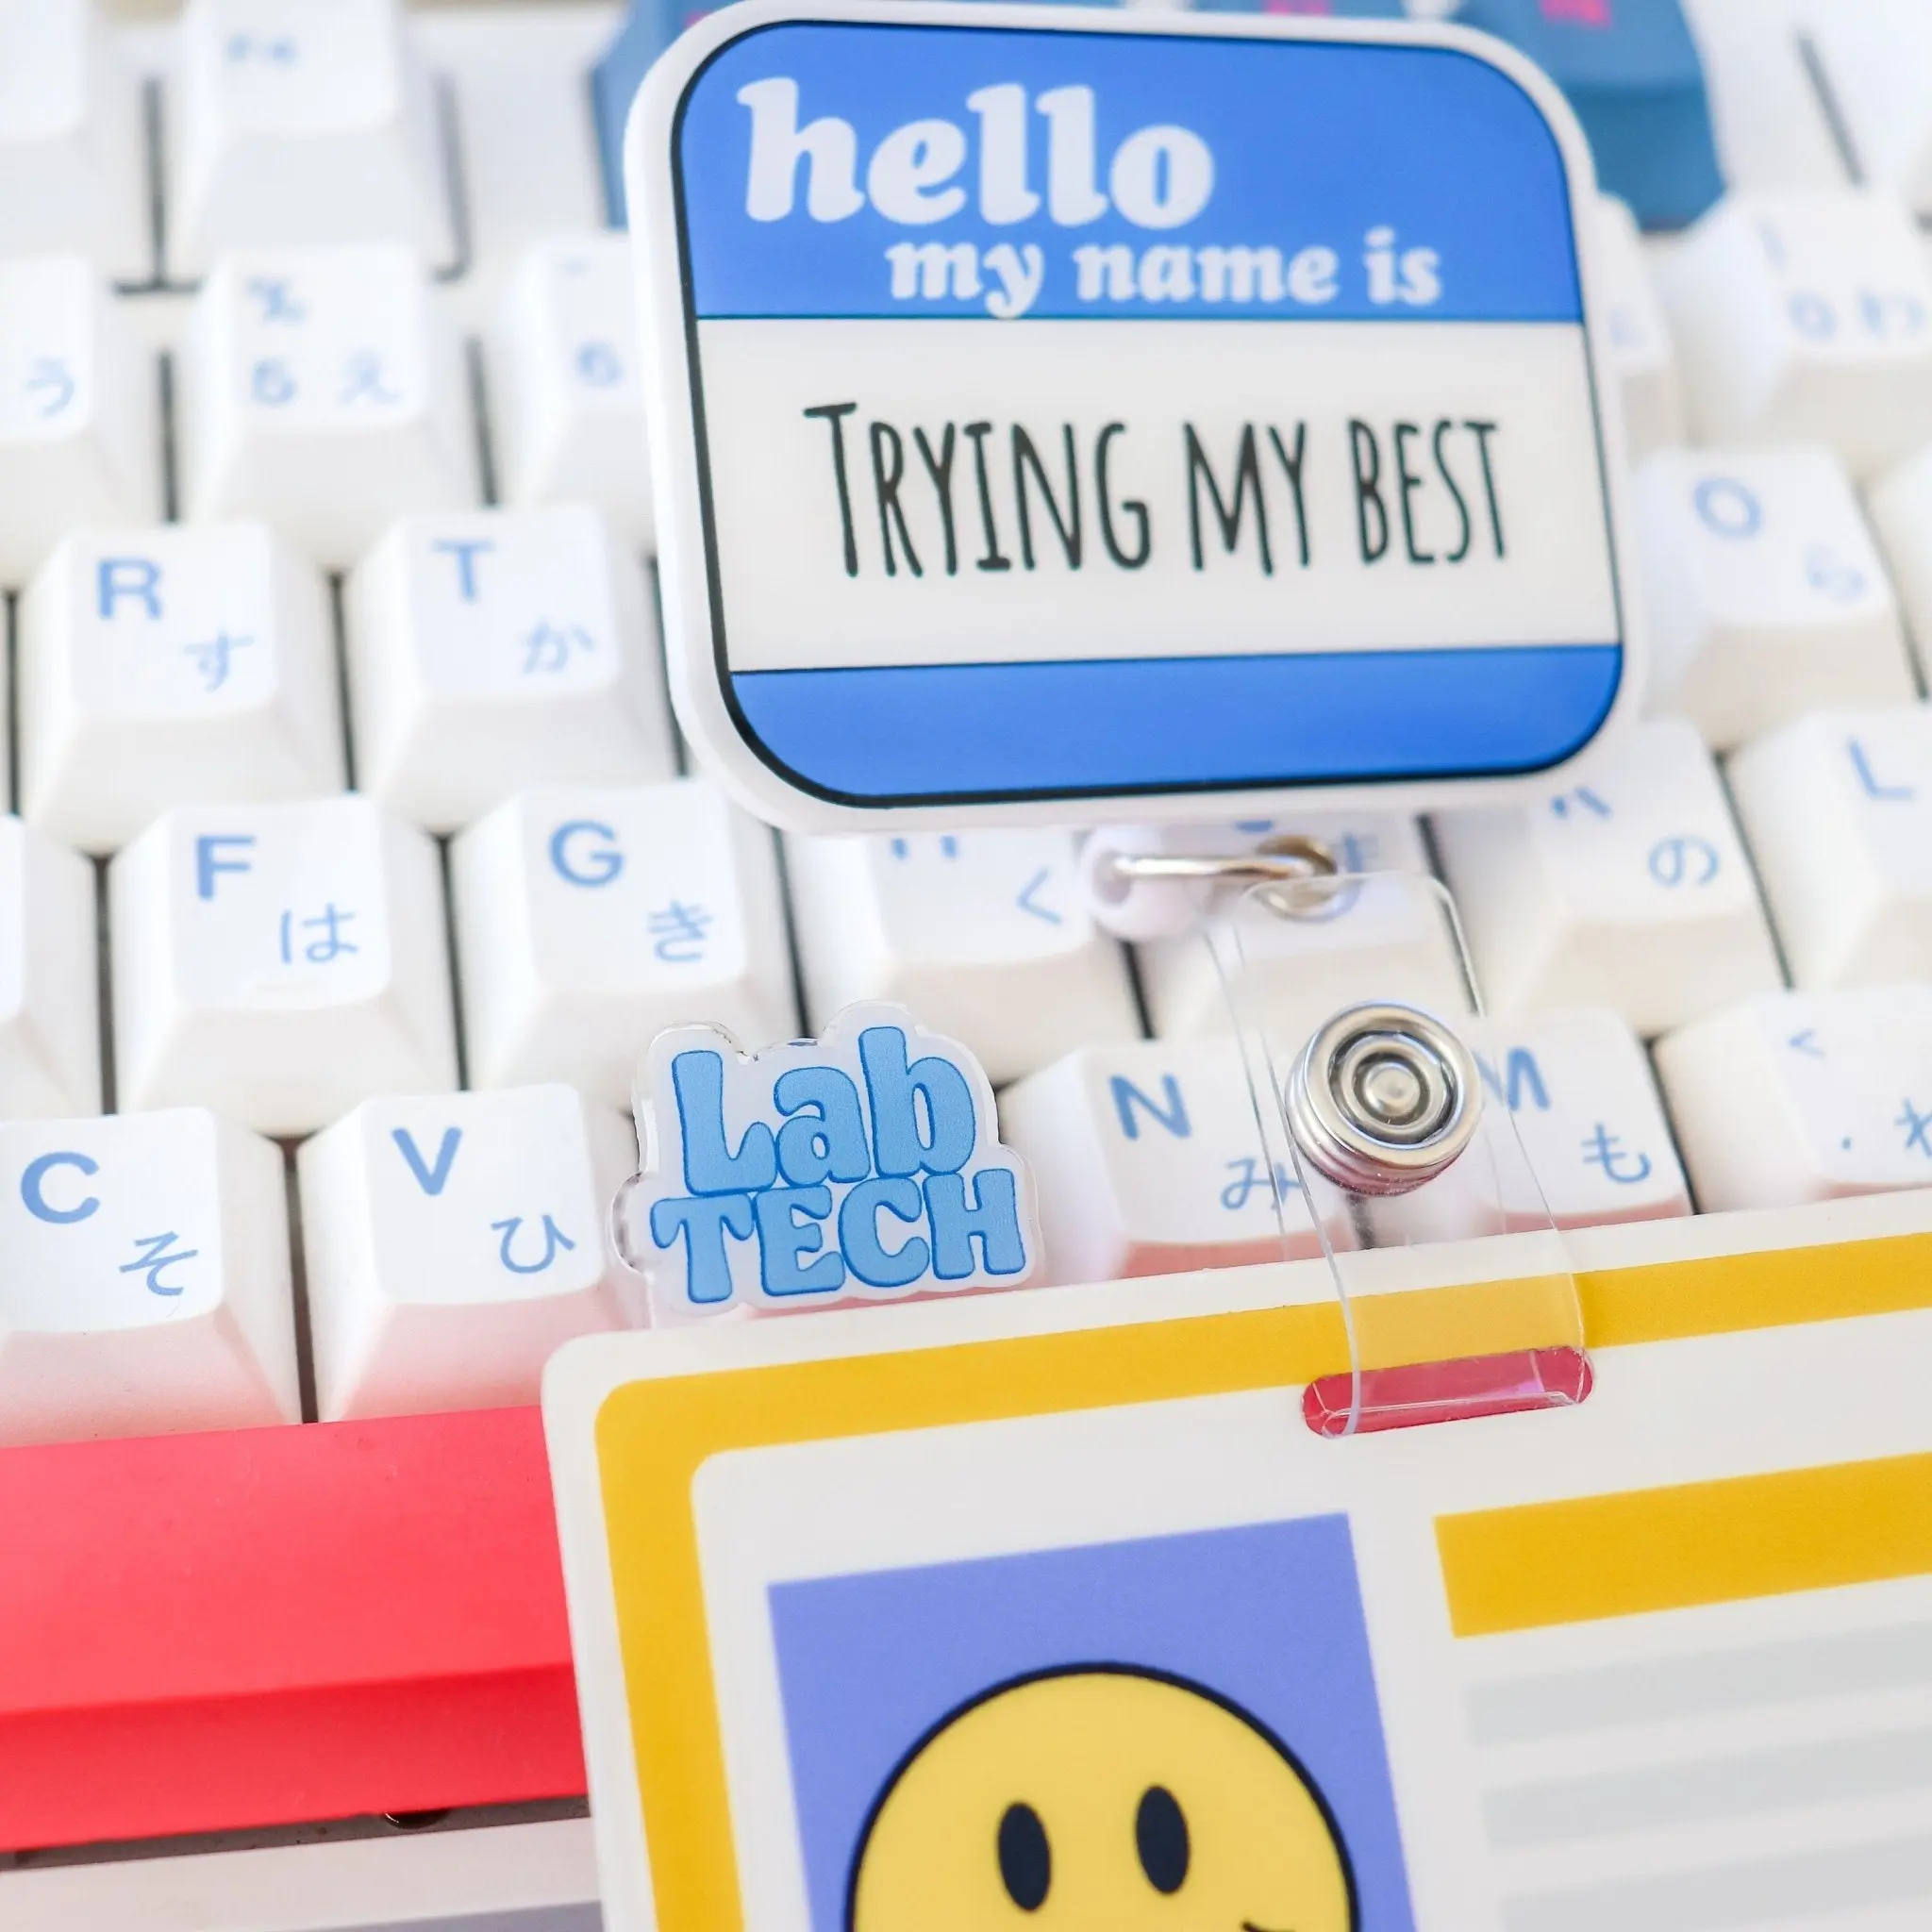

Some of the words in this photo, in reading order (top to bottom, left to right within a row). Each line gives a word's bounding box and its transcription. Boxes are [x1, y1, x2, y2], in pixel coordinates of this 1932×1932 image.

[736, 77, 1215, 228] hello
[885, 242, 1043, 318] my
[1073, 244, 1340, 303] name
[1363, 225, 1441, 305] is
[803, 402, 1152, 578] TRYING
[1183, 421, 1310, 576] MY
[1348, 418, 1505, 565] BEST
[96, 558, 163, 620] R
[434, 539, 494, 603] T
[186, 630, 255, 691] す
[1846, 737, 1914, 801] L
[195, 834, 256, 901] F
[547, 820, 625, 889] G
[1647, 836, 1720, 888] の
[279, 903, 358, 965] は
[671, 1024, 977, 1197] Lab
[1108, 1074, 1191, 1140] N
[391, 1125, 463, 1196] V
[1581, 1123, 1653, 1184] も
[20, 1151, 100, 1224] C
[119, 1231, 198, 1296] そ
[491, 1214, 576, 1276] ひ
[649, 1167, 1026, 1305] TECH
